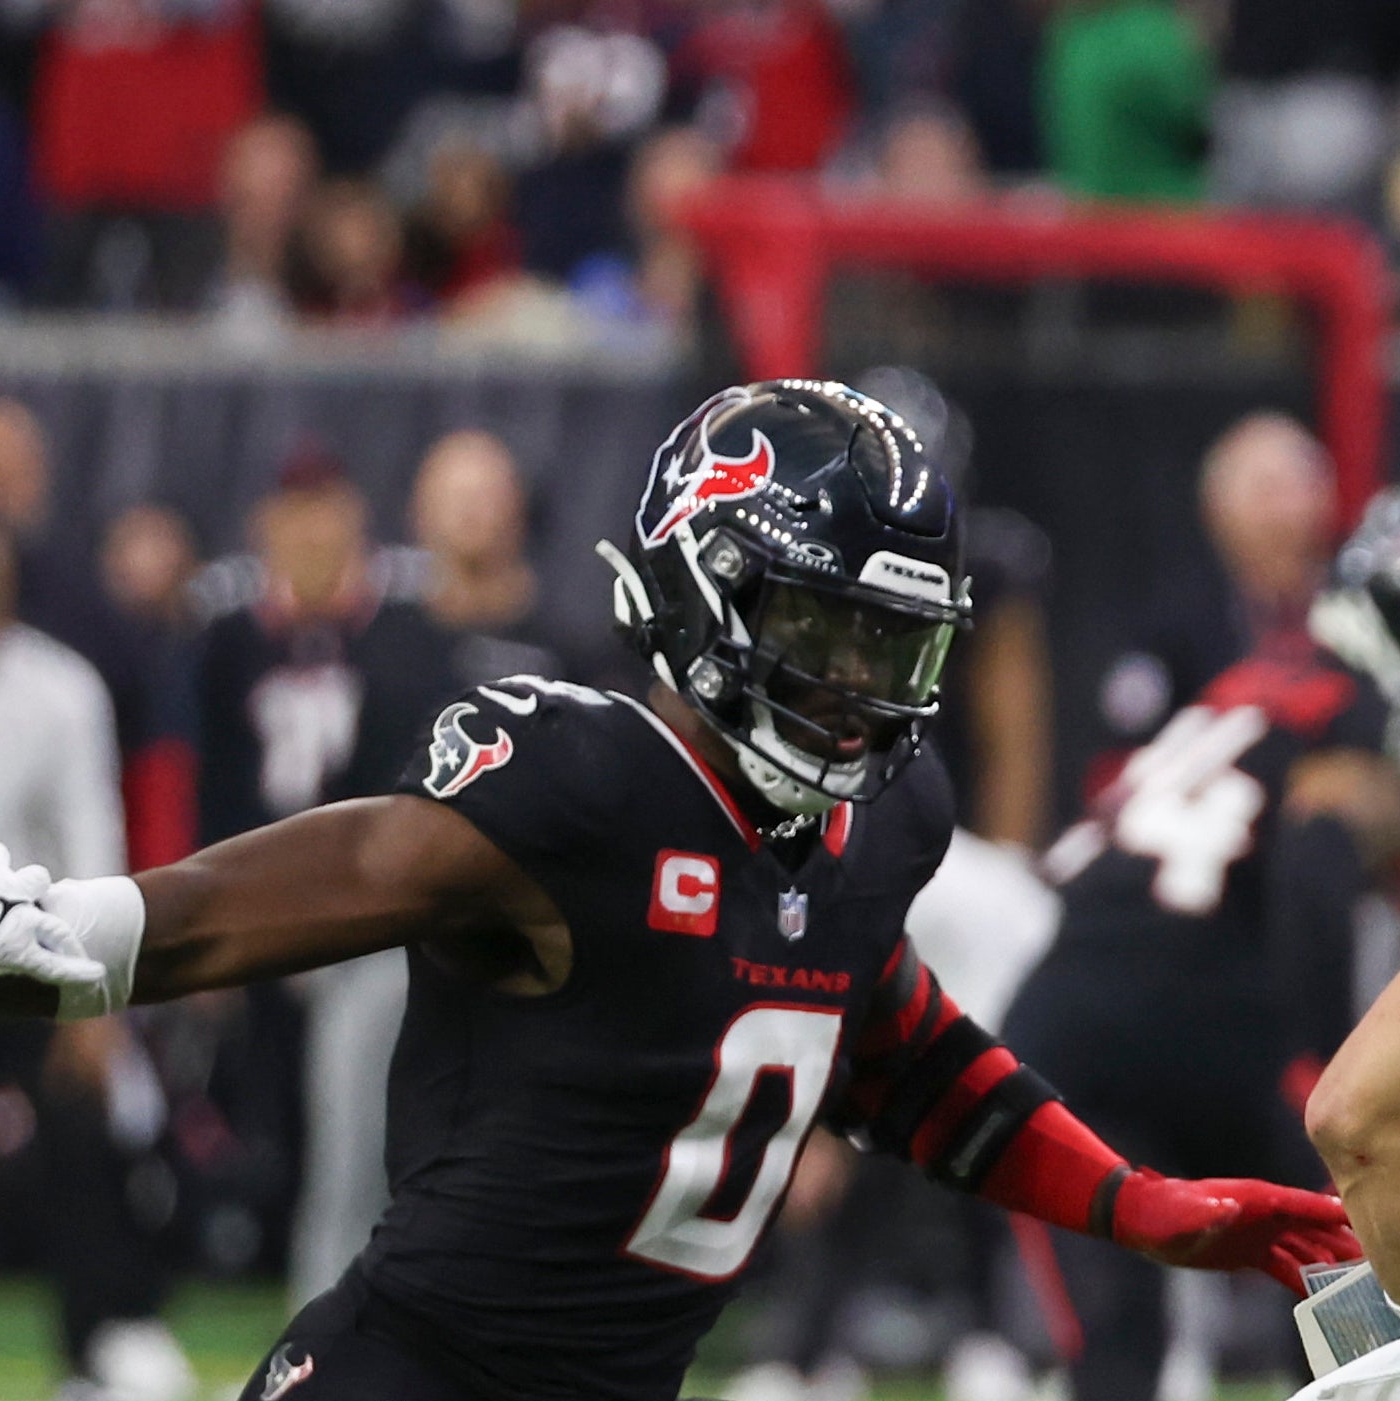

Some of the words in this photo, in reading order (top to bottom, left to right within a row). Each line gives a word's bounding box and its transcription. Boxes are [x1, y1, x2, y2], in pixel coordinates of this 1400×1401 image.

[884, 562, 945, 585] TEXANS
[659, 856, 716, 915] C
[730, 957, 851, 993] TEXANS
[618, 1001, 845, 1284] 0
